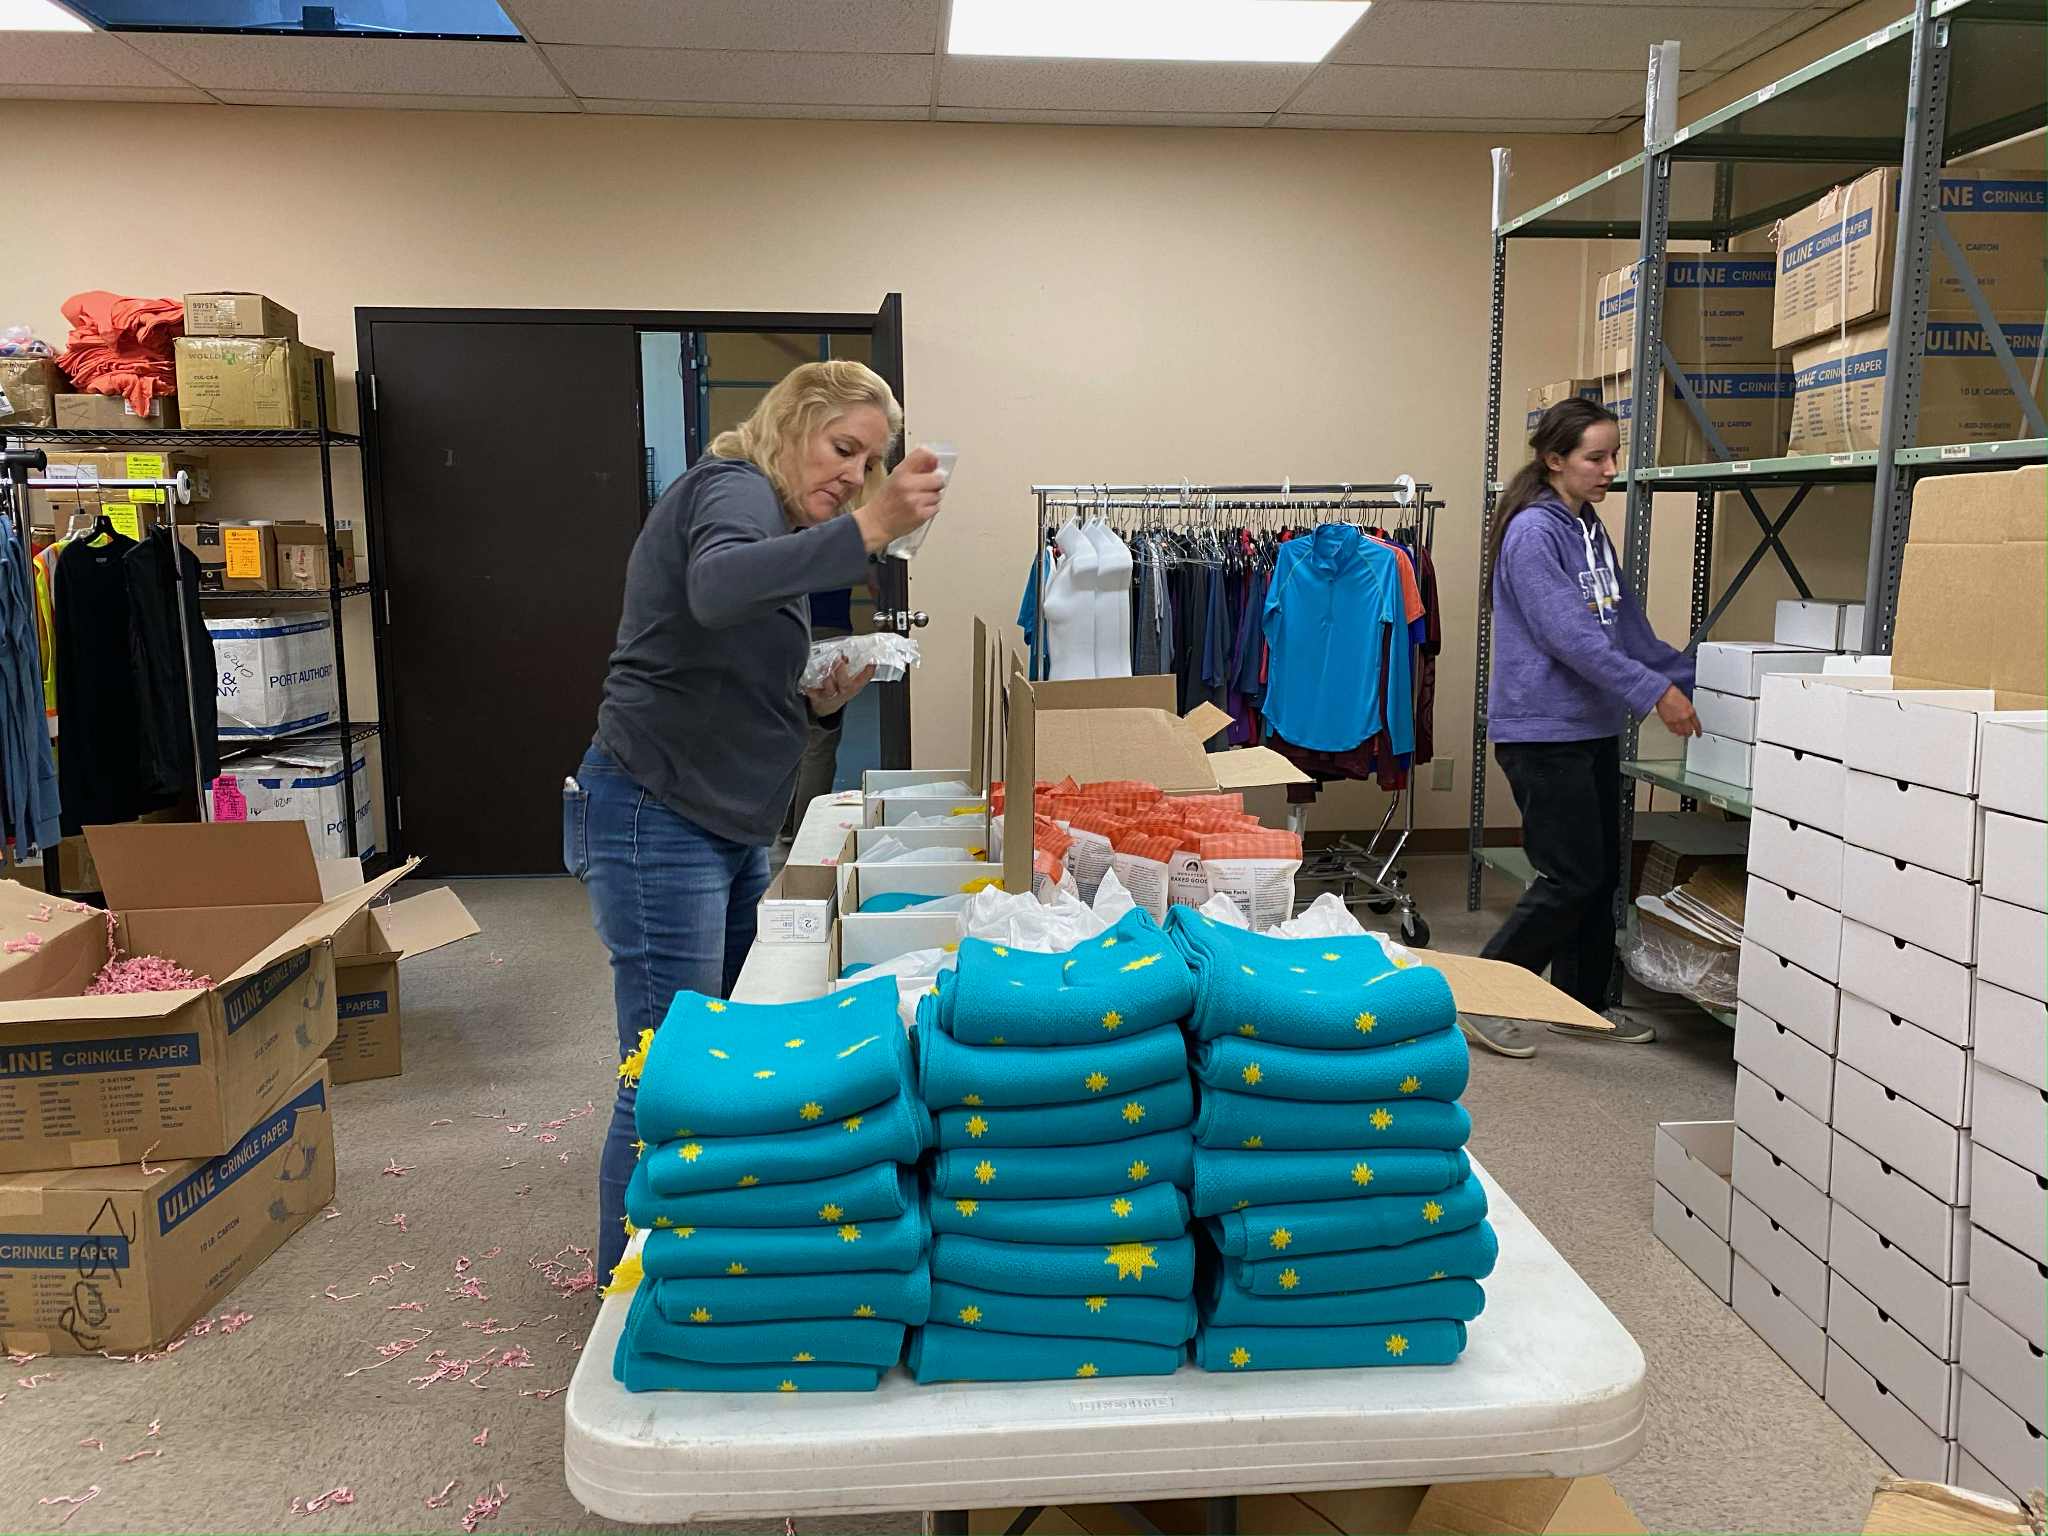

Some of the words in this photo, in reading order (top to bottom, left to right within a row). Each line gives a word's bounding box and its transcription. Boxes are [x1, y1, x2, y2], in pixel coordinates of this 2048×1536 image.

[1983, 190, 2045, 204] CRINKLE
[1785, 242, 1814, 269] ULINE
[1815, 230, 1844, 252] CRINKL
[1673, 267, 1728, 283] ULINE
[1926, 329, 1993, 351] ULINE
[1818, 364, 1853, 382] CRINLE
[1853, 359, 1882, 375] PAPER
[221, 672, 237, 685] &
[269, 672, 298, 689] PORT
[228, 981, 265, 1026] ULINE
[345, 999, 380, 1012] PAPER
[62, 1048, 134, 1067] CRINKLE
[138, 1044, 189, 1061] PAPER
[164, 1168, 217, 1224] ULINE
[219, 1138, 260, 1180] CRINKLE
[260, 1119, 289, 1149] PAPER
[0, 1245, 65, 1260] CRINKLE
[69, 1246, 119, 1261] PAPER
